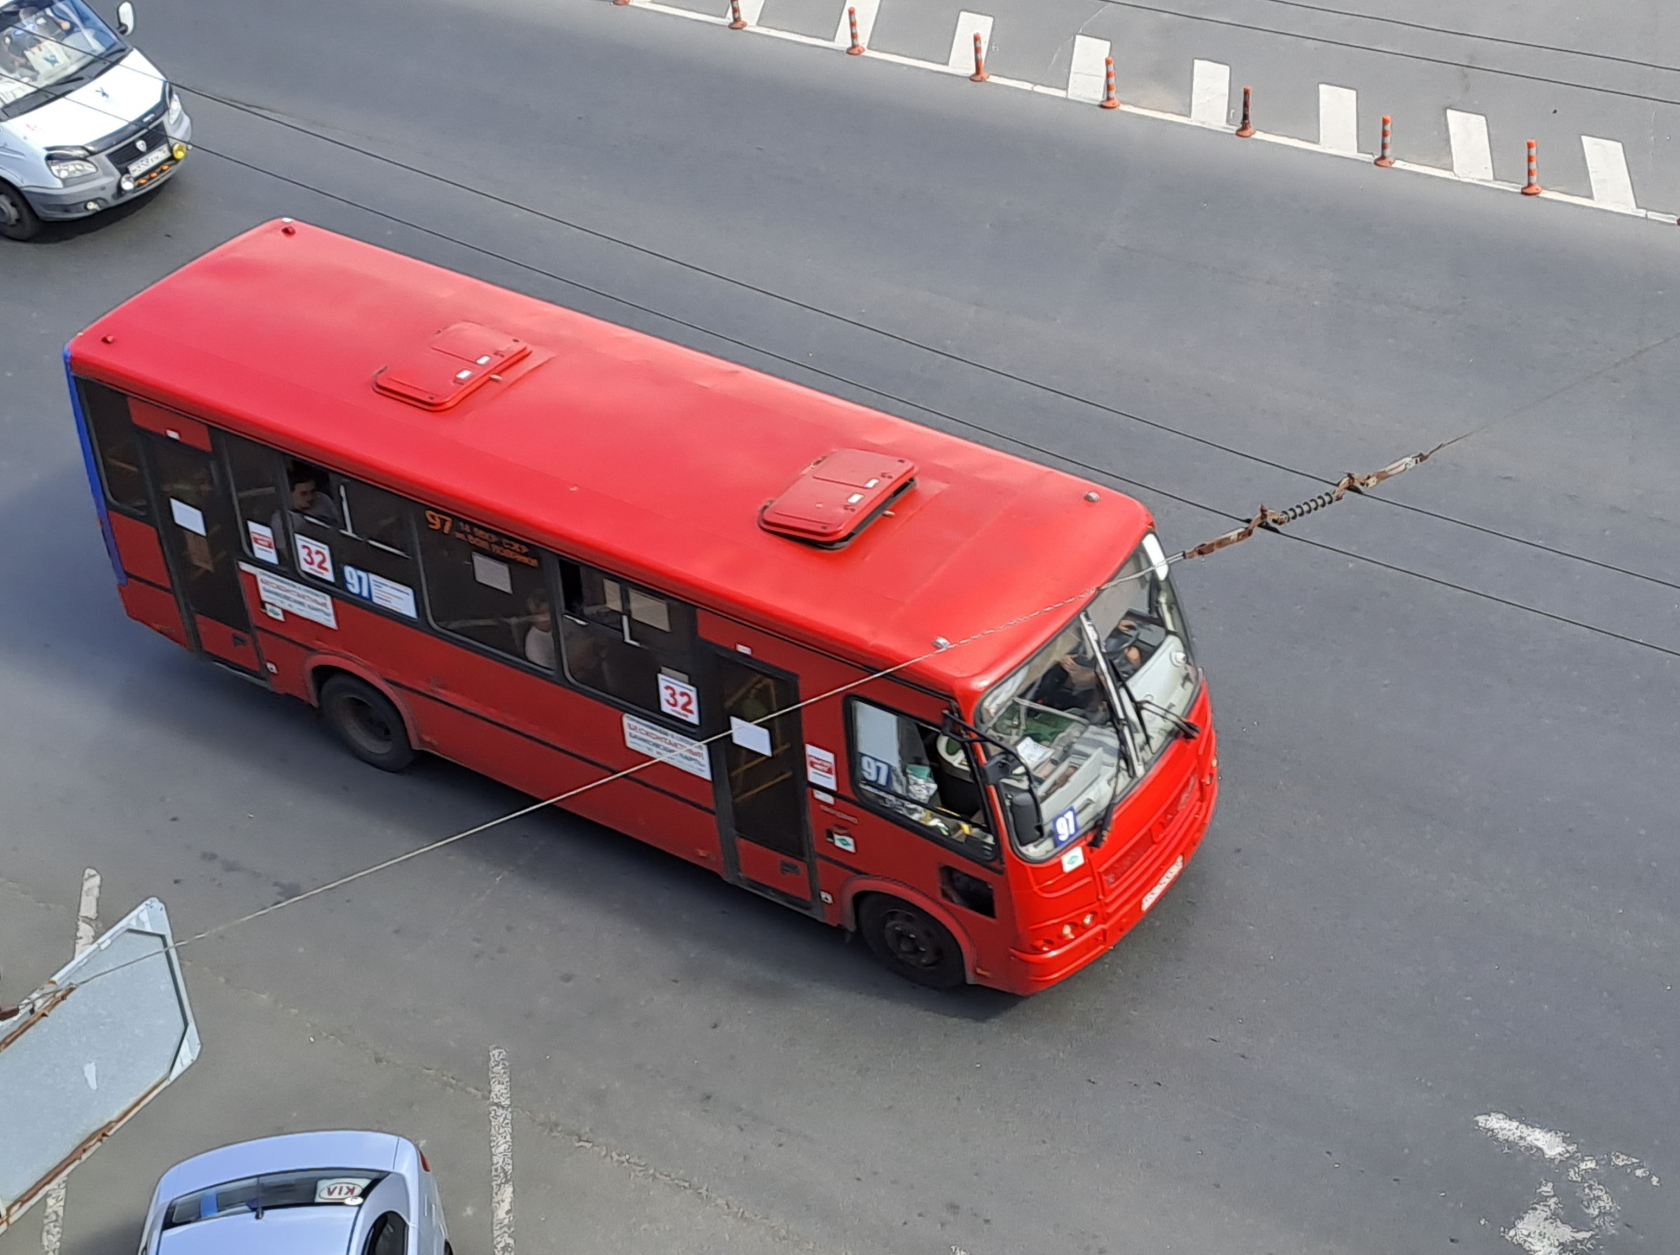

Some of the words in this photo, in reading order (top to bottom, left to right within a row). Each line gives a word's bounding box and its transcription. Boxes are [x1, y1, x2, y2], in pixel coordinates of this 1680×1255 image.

[425, 510, 452, 534] 97
[301, 544, 329, 572] 32
[344, 565, 369, 598] 97
[664, 685, 694, 715] 32
[861, 756, 888, 786] 97
[1055, 810, 1075, 841] 97
[327, 1186, 356, 1196] KIA
